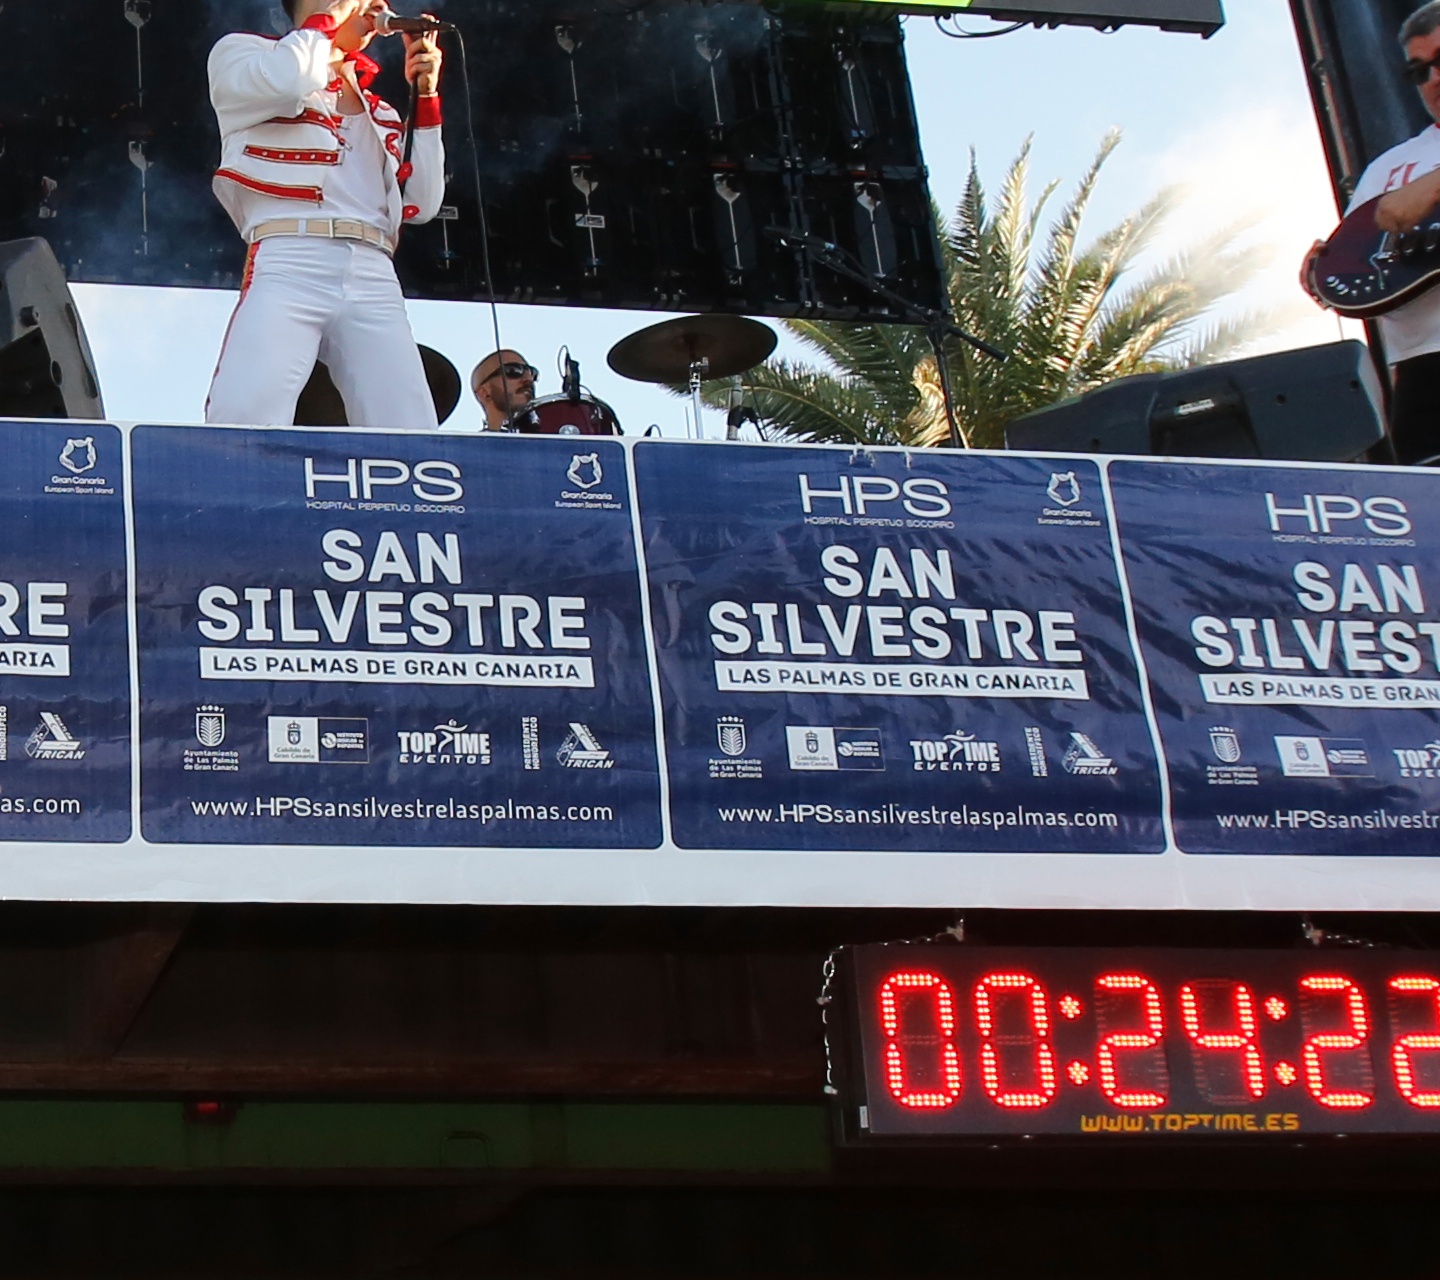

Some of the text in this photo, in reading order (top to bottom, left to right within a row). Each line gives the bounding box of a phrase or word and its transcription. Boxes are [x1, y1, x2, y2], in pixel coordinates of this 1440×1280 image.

[303, 457, 464, 502] HPS
[798, 474, 952, 518] HPS
[1265, 492, 1411, 536] HPS
[322, 529, 463, 585] SAN
[820, 545, 957, 600] SAN
[1293, 562, 1425, 615] SAN
[197, 586, 591, 650] SILVESTRE
[708, 601, 1083, 663] SILVESTRE
[191, 795, 613, 824] www.HPSsansilvestrelaspalmas.com
[1080, 1113, 1300, 1133] WWW.TOPTIME.ES
